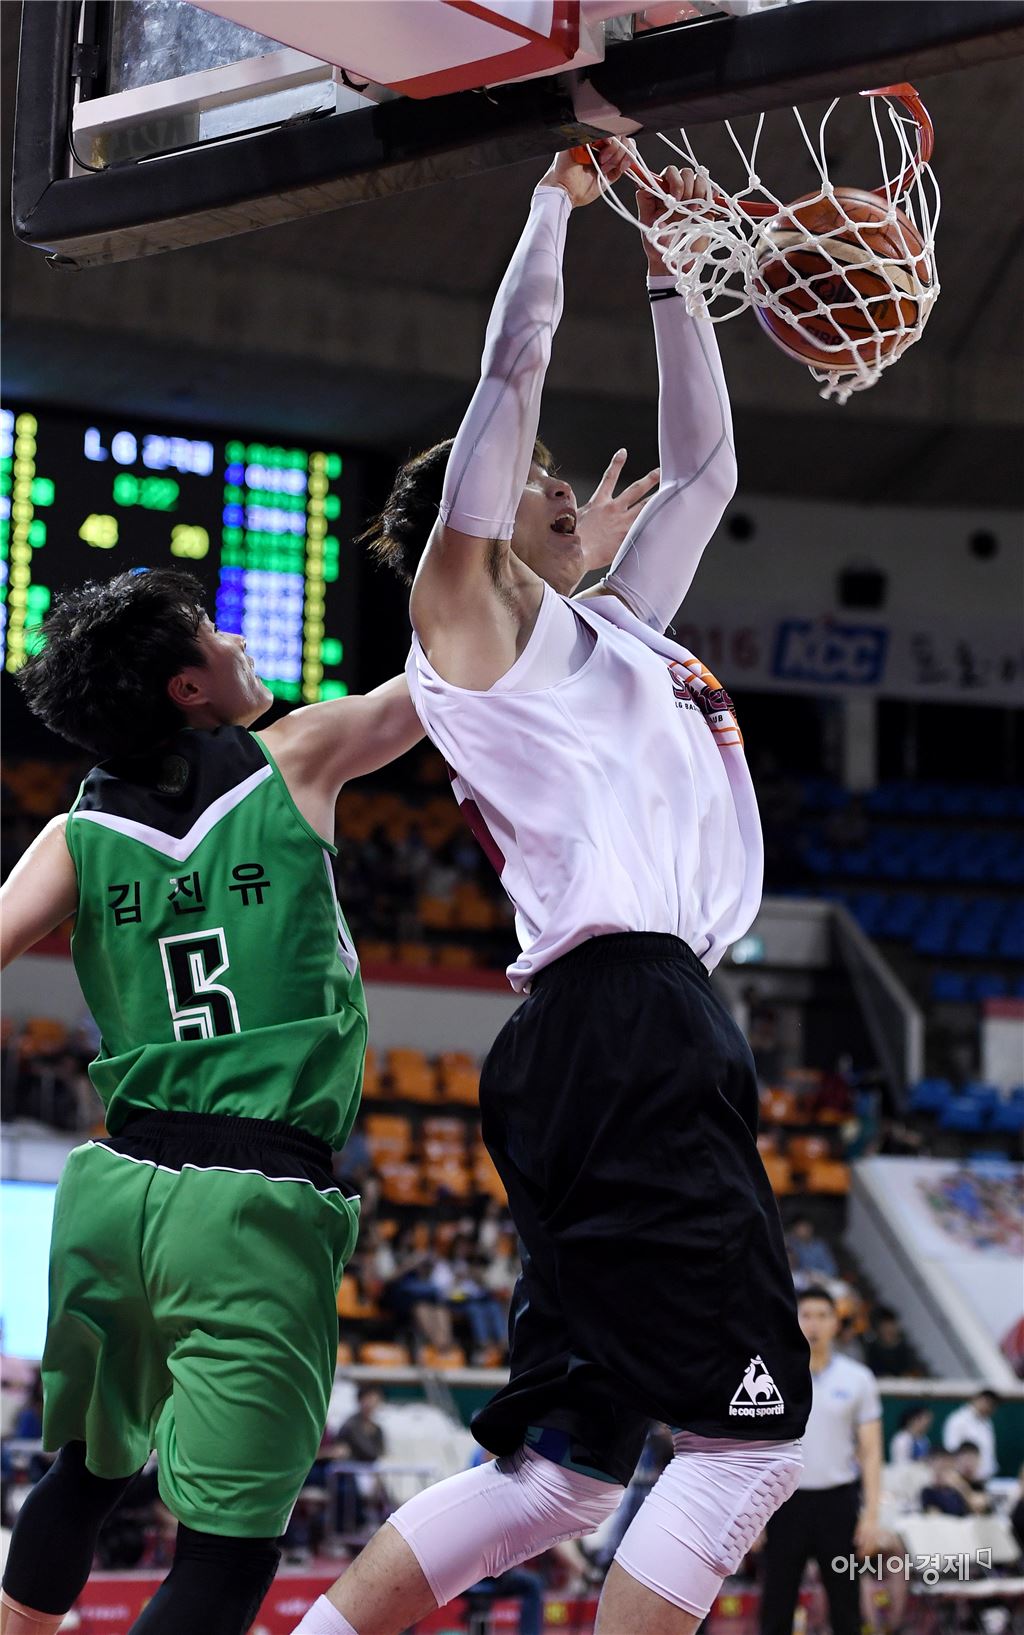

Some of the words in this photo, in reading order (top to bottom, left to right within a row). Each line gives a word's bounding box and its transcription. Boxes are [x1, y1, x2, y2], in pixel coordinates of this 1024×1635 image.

[158, 927, 241, 1042] 5
[729, 1405, 738, 1416] le
[738, 1407, 755, 1418] coq
[756, 1404, 784, 1417] sportif
